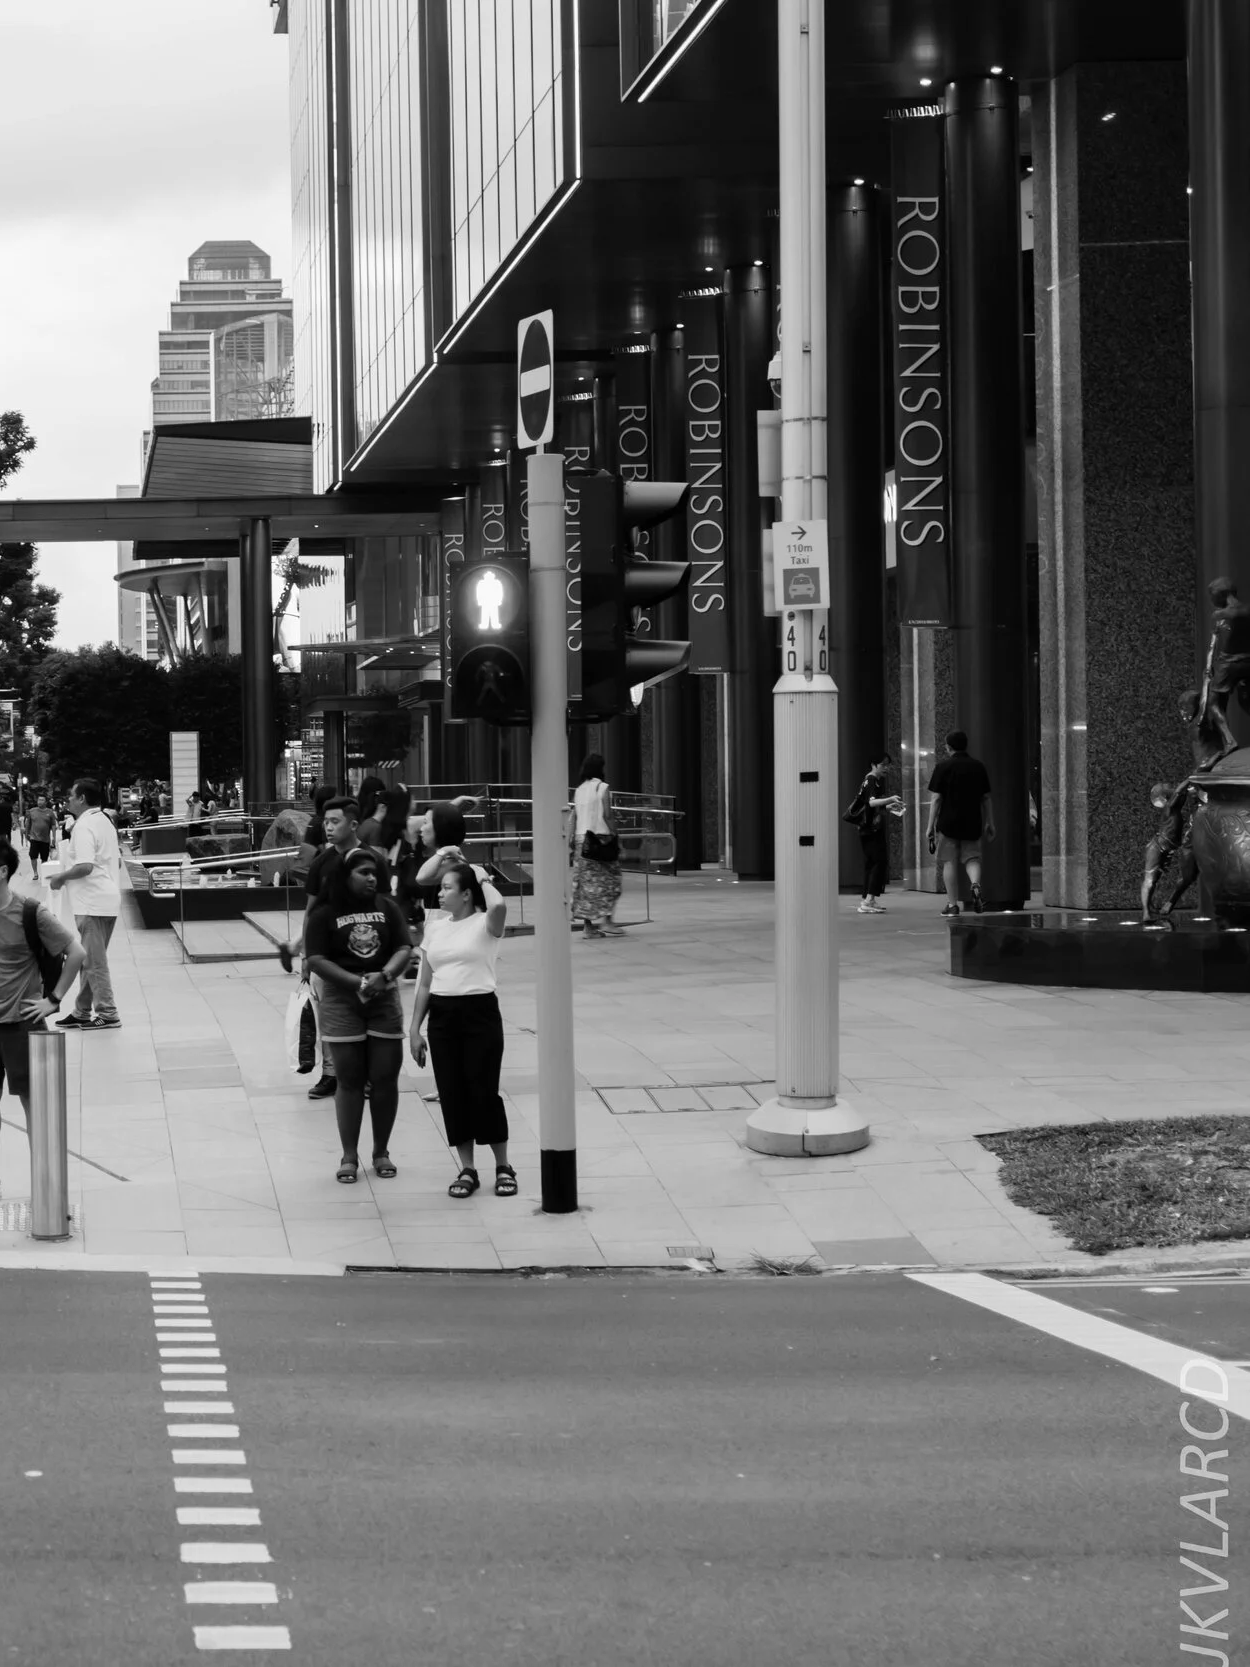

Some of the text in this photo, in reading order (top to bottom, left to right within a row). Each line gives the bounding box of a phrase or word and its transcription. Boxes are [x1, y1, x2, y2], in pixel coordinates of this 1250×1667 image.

[896, 196, 945, 547] ROBINSONS
[688, 354, 725, 613] ROBINSONS
[787, 544, 813, 553] 110m
[790, 556, 810, 565] Taxi
